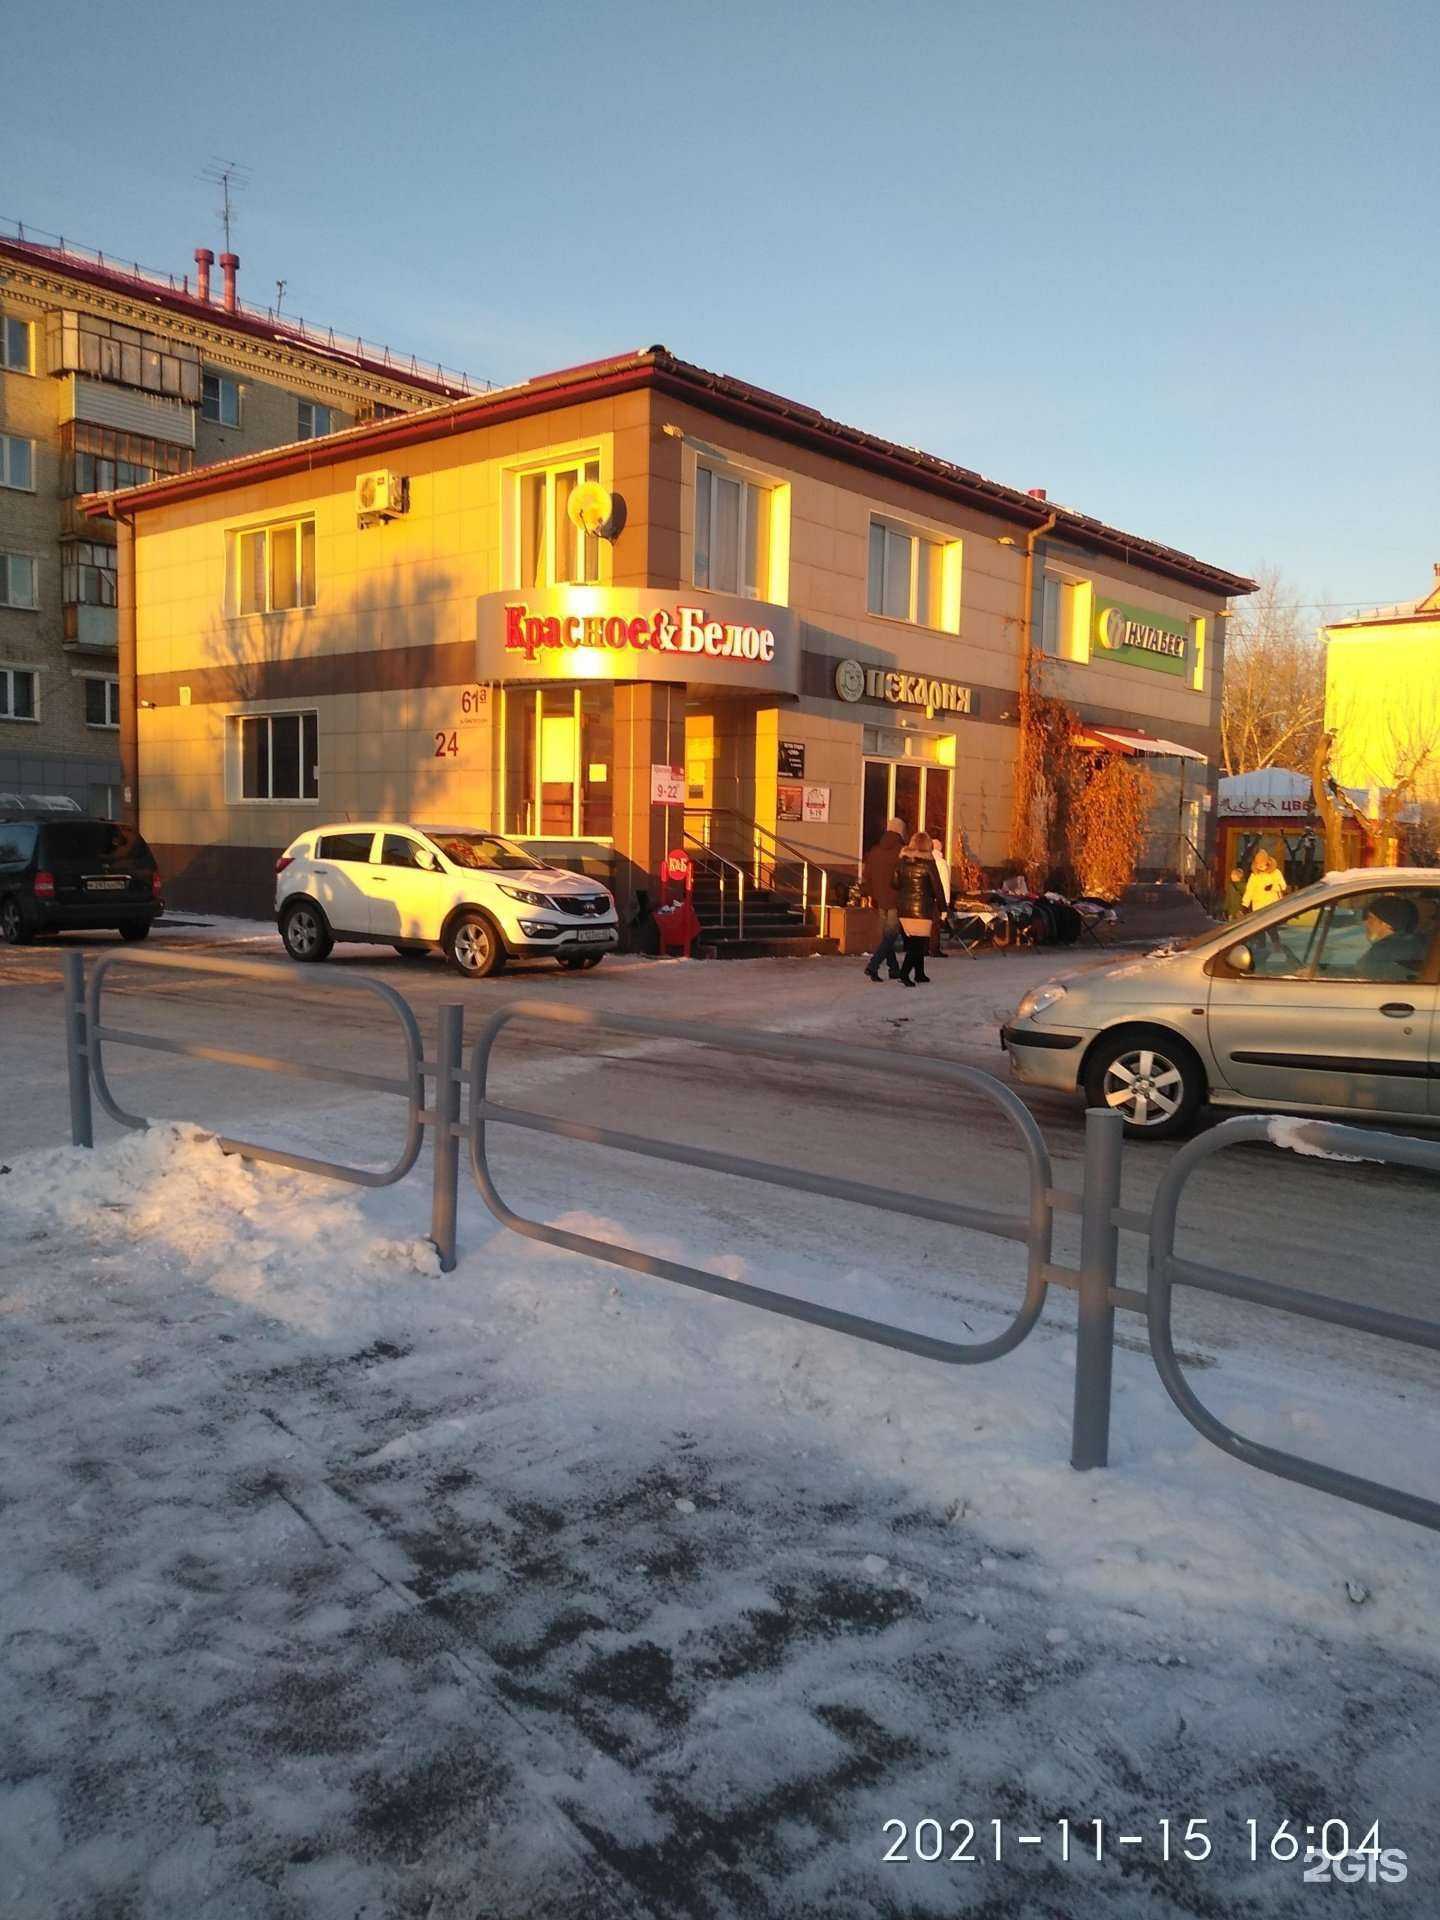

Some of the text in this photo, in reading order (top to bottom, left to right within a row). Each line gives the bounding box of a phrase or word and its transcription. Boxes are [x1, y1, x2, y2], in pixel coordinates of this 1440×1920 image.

[504, 603, 776, 662] Красное&Белое
[434, 731, 459, 757] 24
[1281, 800, 1315, 812] ЦВЕ
